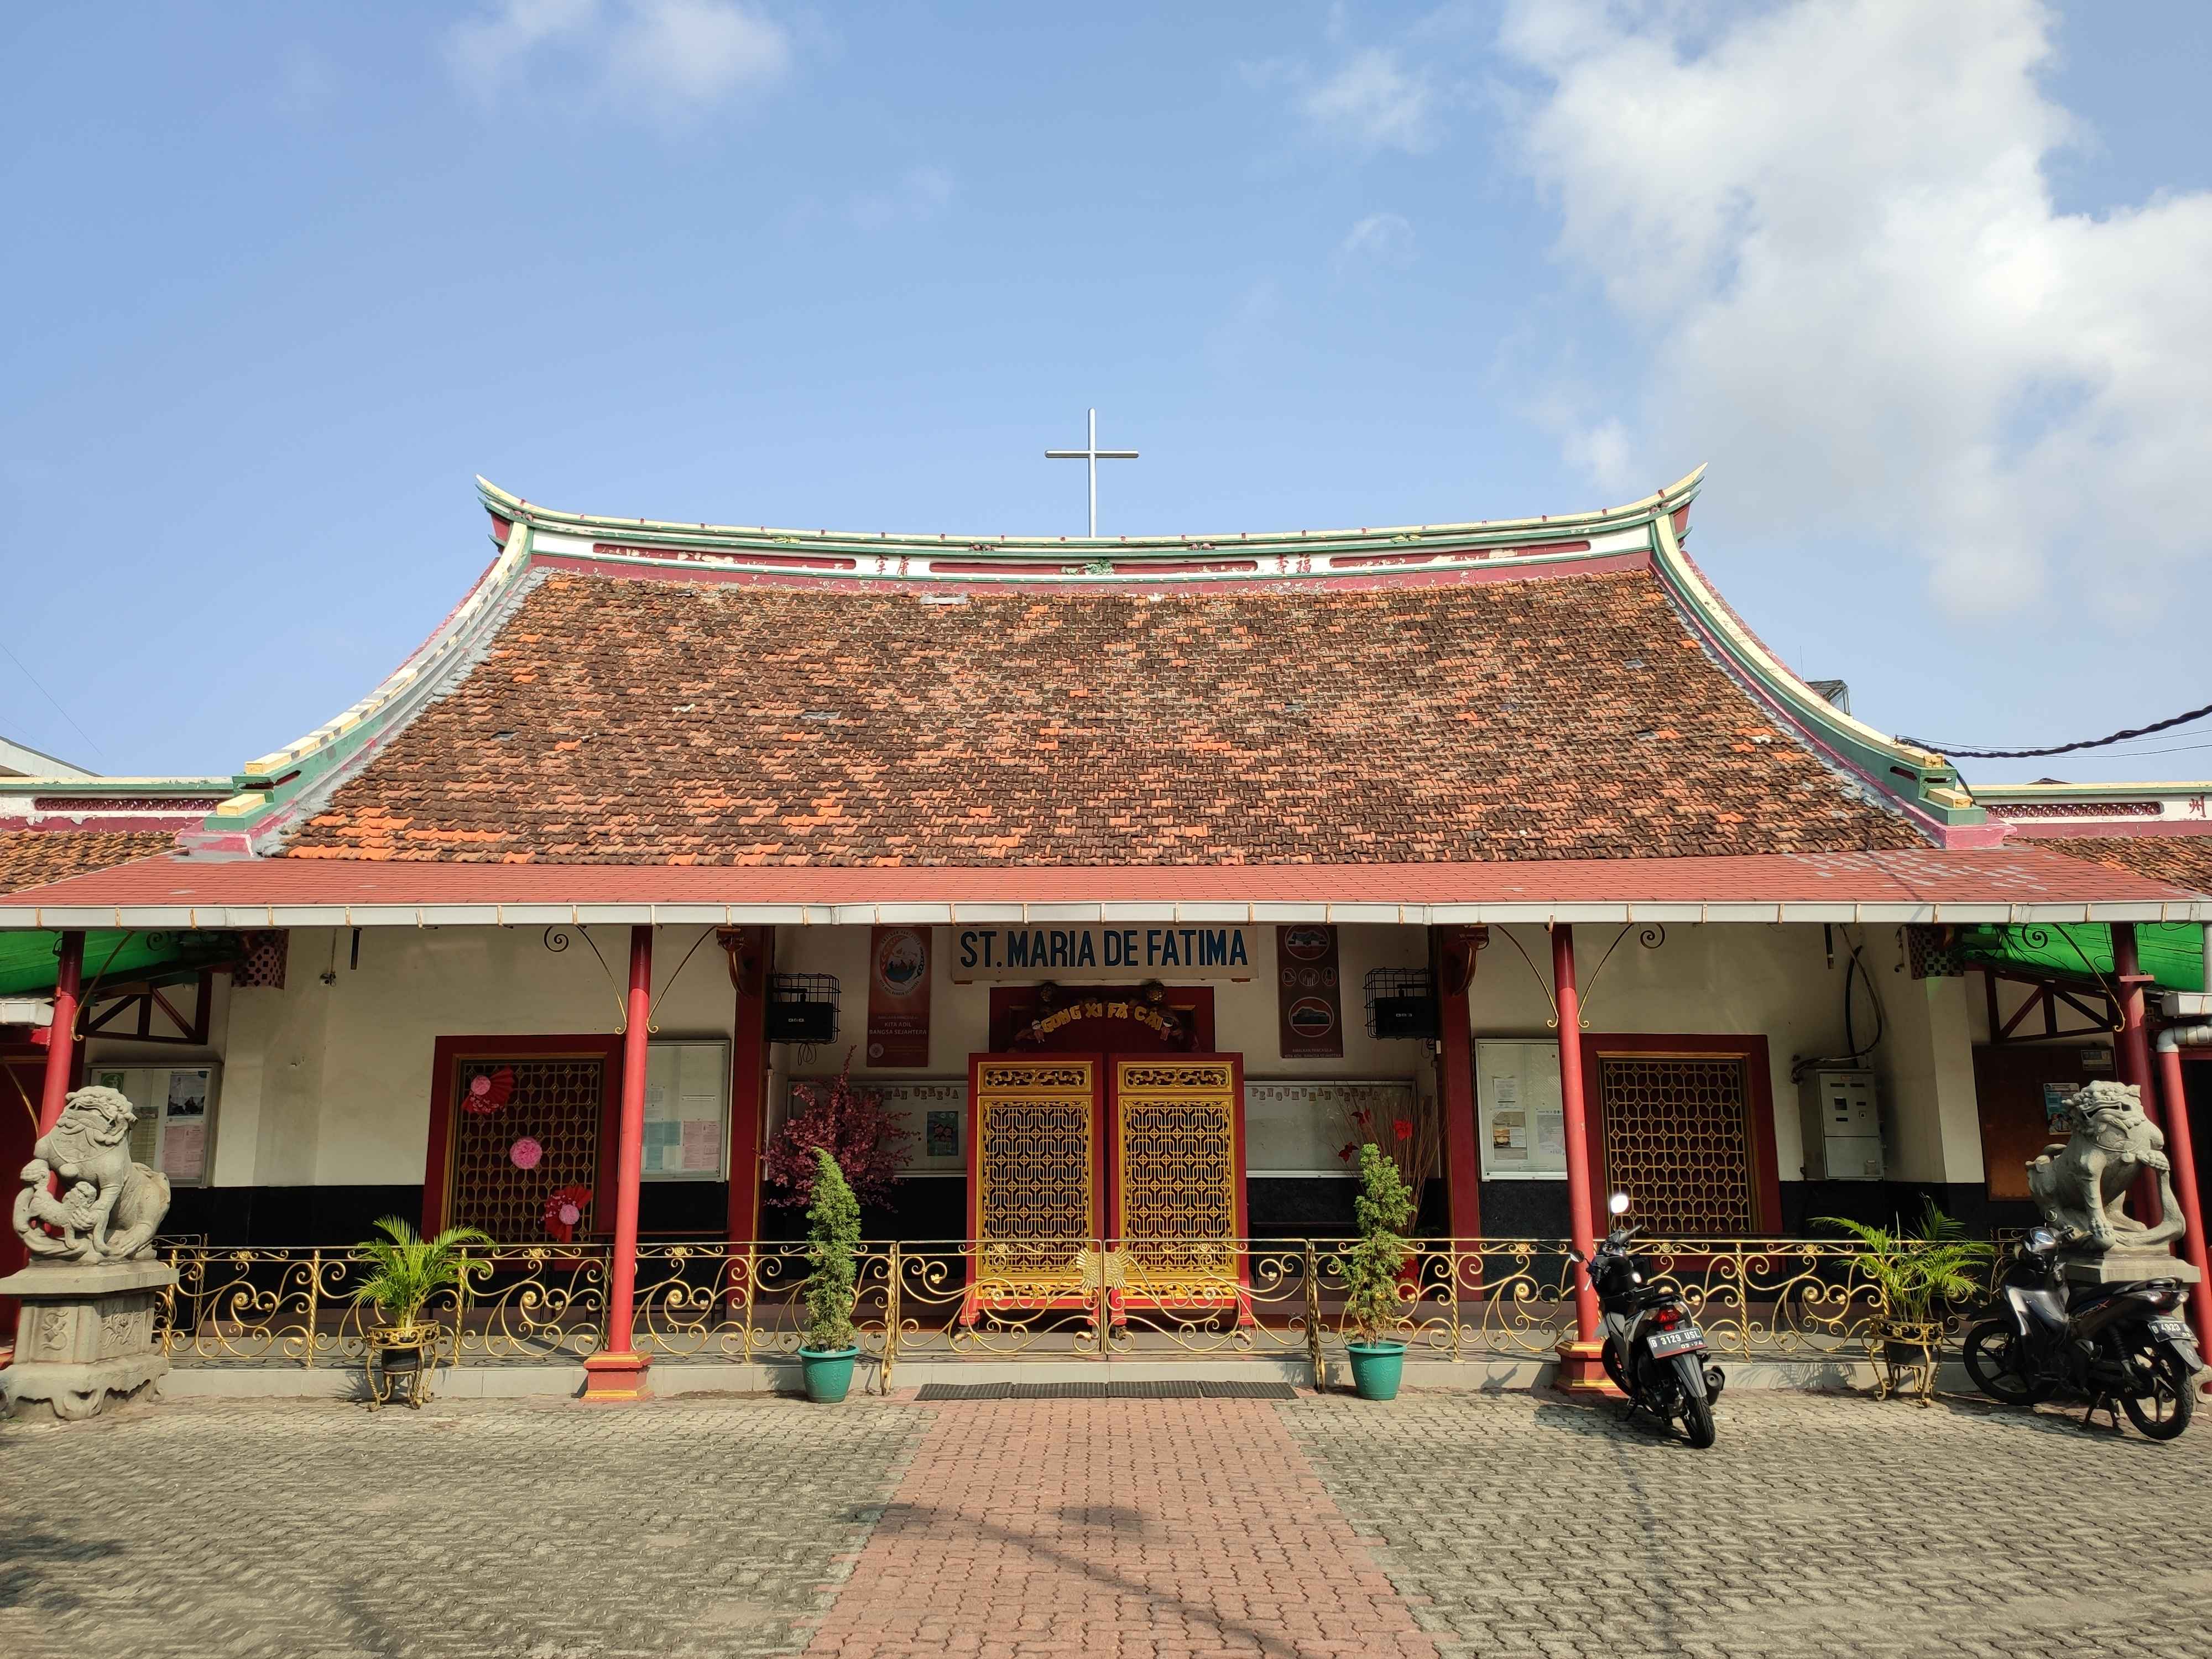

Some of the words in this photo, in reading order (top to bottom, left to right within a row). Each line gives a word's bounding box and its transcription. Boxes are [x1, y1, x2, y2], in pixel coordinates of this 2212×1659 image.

[960, 930, 1002, 968] ST.
[1007, 930, 1096, 968] MARIA
[1104, 930, 1139, 967] DE
[1146, 929, 1248, 967] FATIMA
[1040, 1005, 1082, 1033] GONG
[1085, 1002, 1103, 1018] XI
[1108, 1002, 1129, 1019] FA
[1134, 1006, 1164, 1031] CAI
[1661, 1334, 1681, 1345] 3129
[1684, 1331, 1700, 1339] USL
